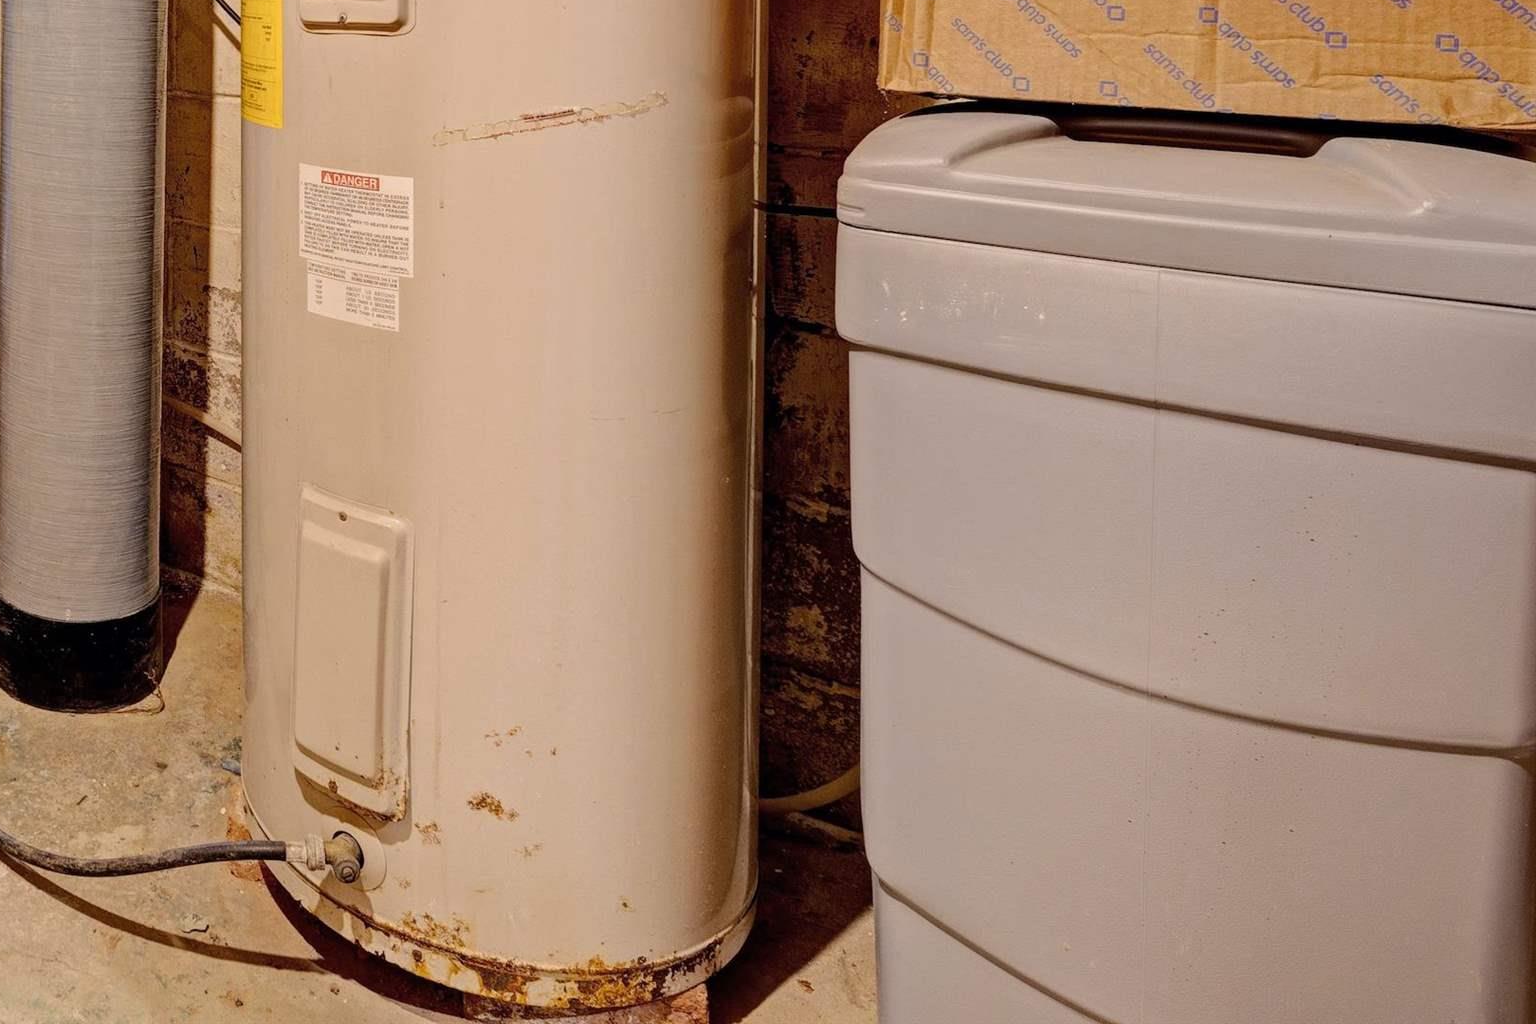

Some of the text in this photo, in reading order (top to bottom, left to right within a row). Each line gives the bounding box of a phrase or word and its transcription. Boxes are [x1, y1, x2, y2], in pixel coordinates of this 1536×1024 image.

[1289, 1, 1325, 33] club
[951, 17, 1014, 77] sam's club
[1044, 23, 1082, 58] sam's
[1219, 22, 1296, 88] sam's club
[1143, 43, 1215, 108] sam's club
[1459, 50, 1500, 84] club
[1369, 74, 1420, 114] sam's
[333, 173, 378, 190] DANGER
